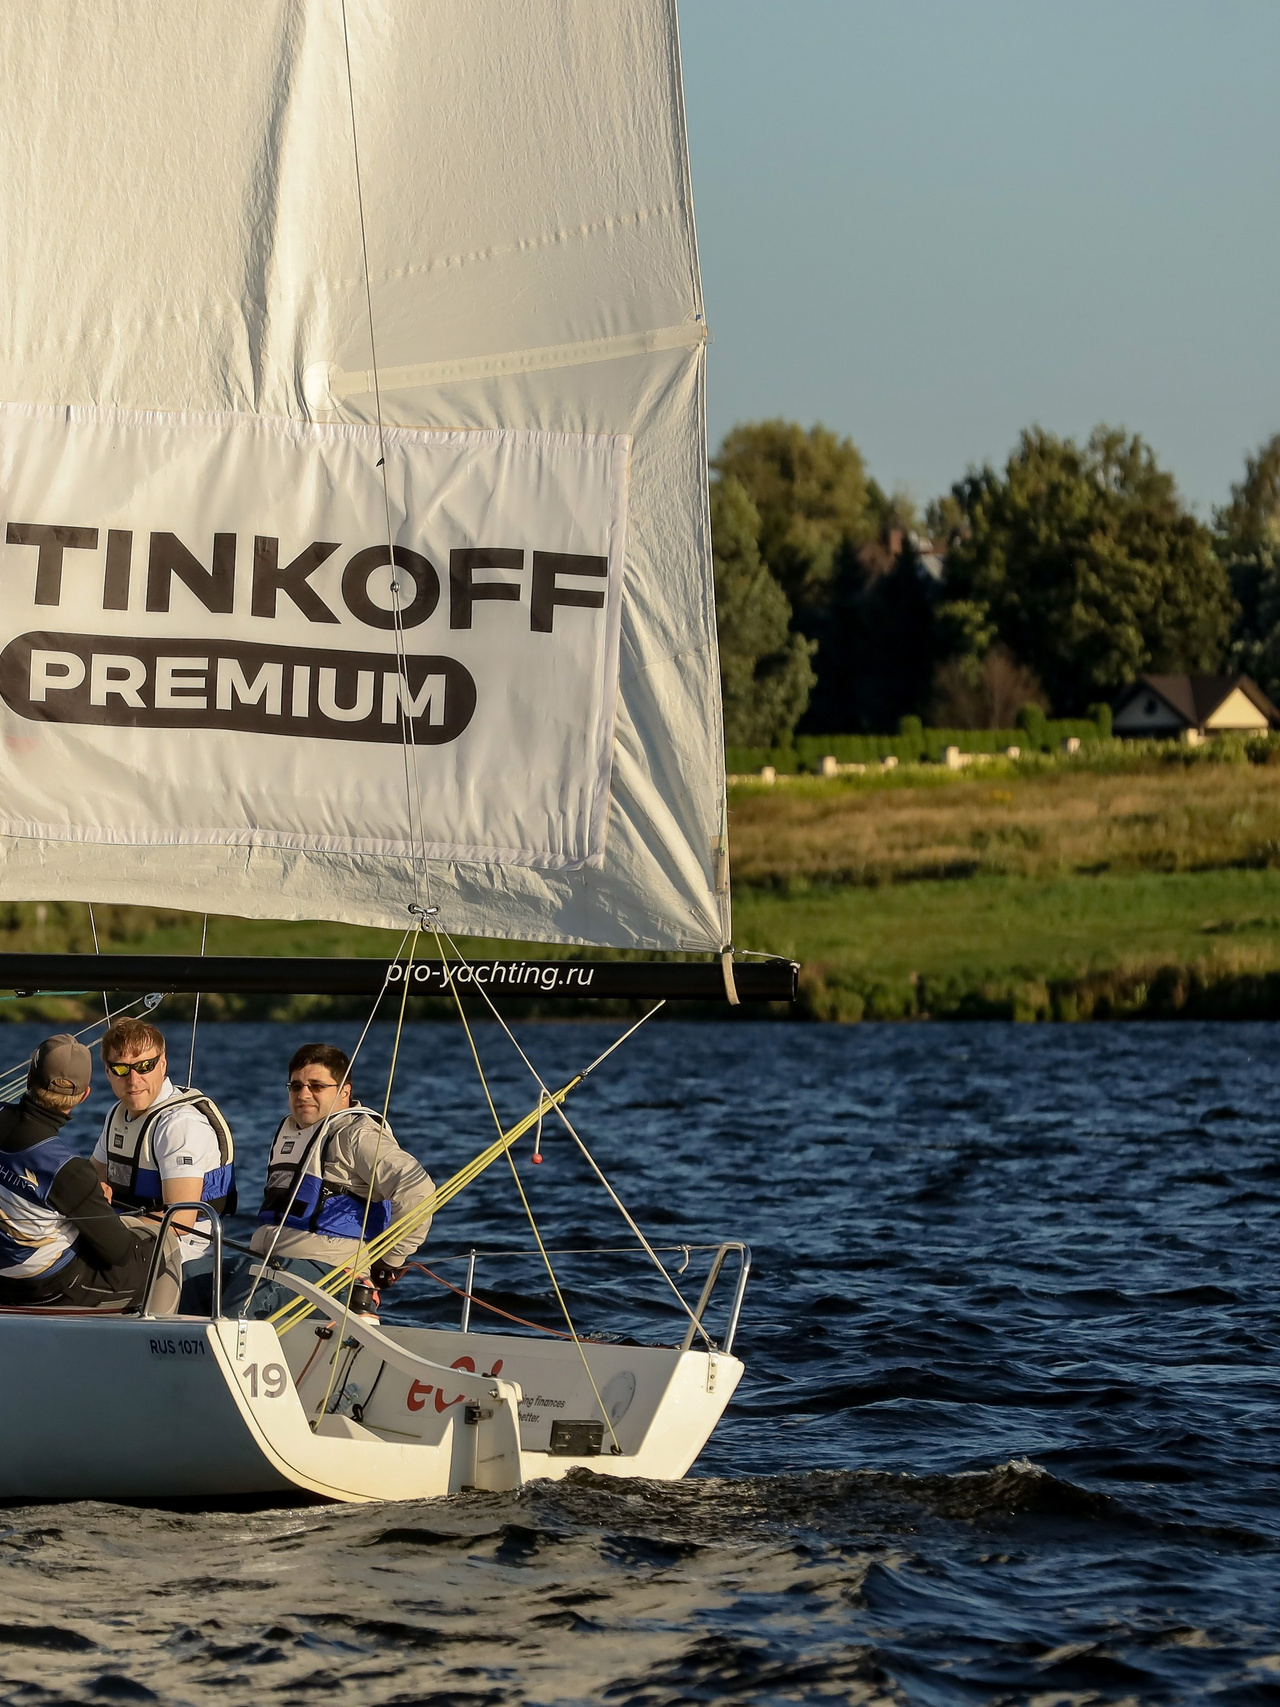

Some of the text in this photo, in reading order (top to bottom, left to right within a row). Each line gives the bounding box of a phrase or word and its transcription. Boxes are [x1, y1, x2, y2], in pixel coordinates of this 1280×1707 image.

[6, 521, 609, 634] TINKOFF
[29, 648, 447, 727] PREMIUM
[384, 960, 595, 990] pro-yachting.ru
[150, 1340, 205, 1354] RUS 1071
[242, 1363, 287, 1398] 19
[534, 1395, 566, 1408] finances
